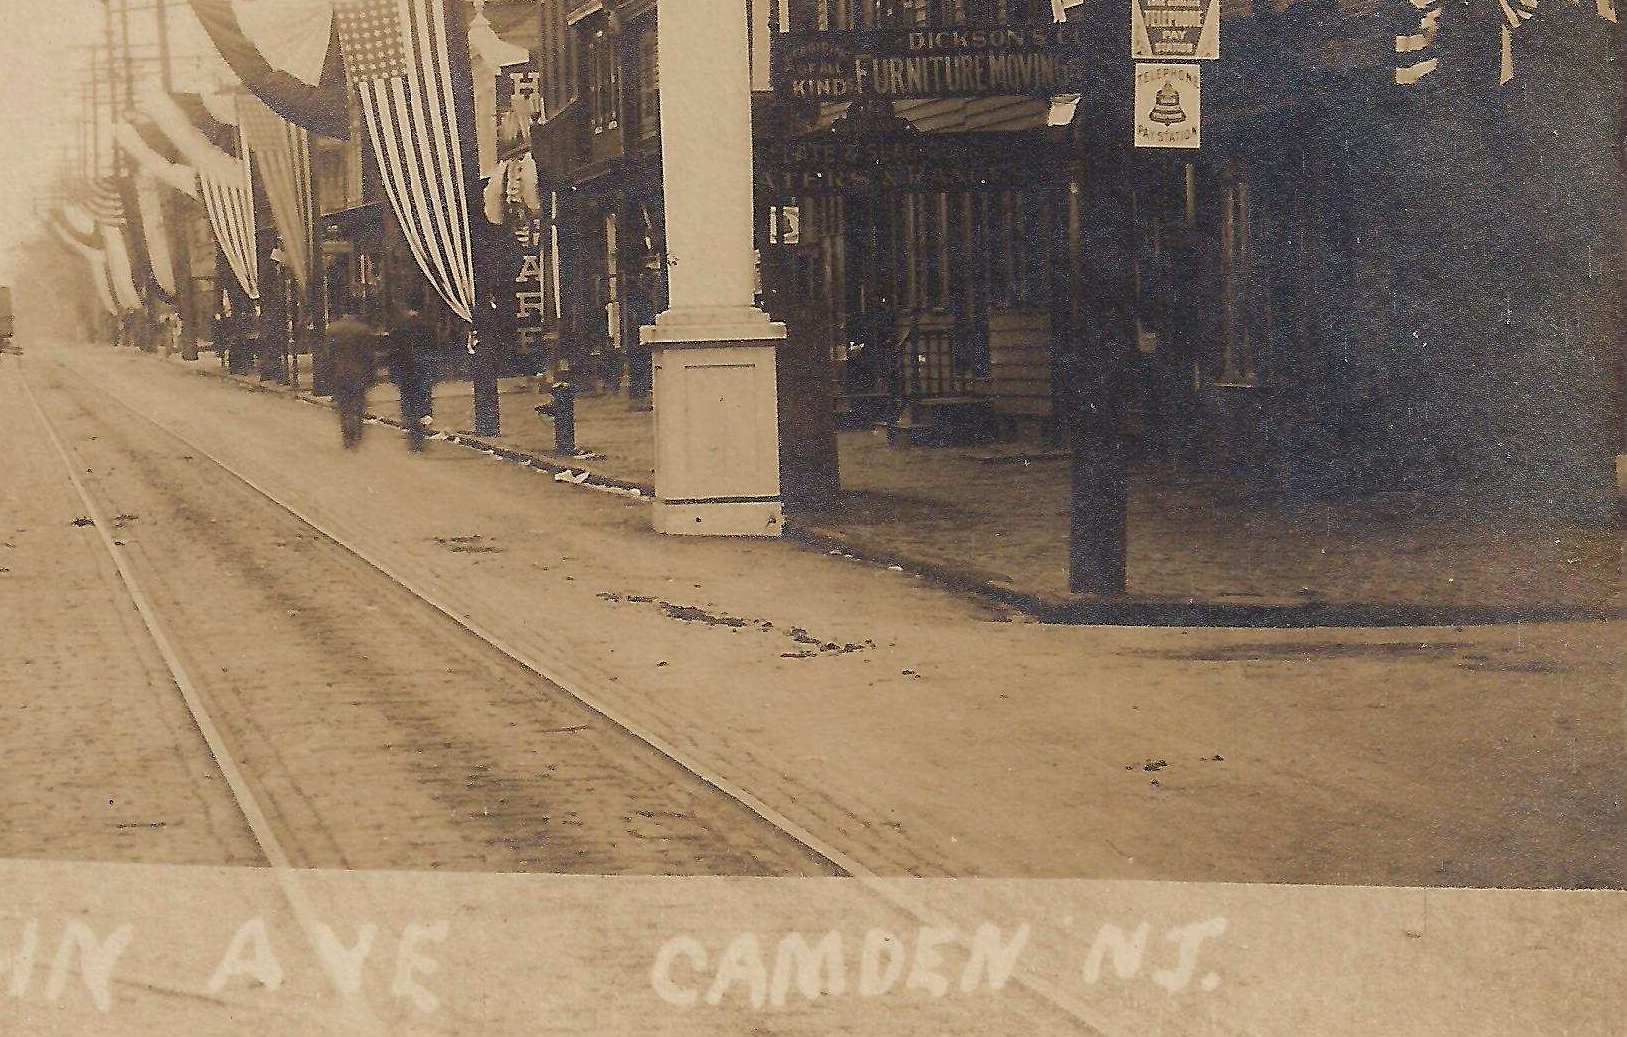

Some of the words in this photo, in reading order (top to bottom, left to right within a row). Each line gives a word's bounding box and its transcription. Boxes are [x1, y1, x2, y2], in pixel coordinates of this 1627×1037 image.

[908, 28, 1024, 51] DICKSON
[1162, 29, 1188, 41] PAY
[855, 55, 987, 94] FURNITURE
[1138, 68, 1200, 89] TELEPHONE
